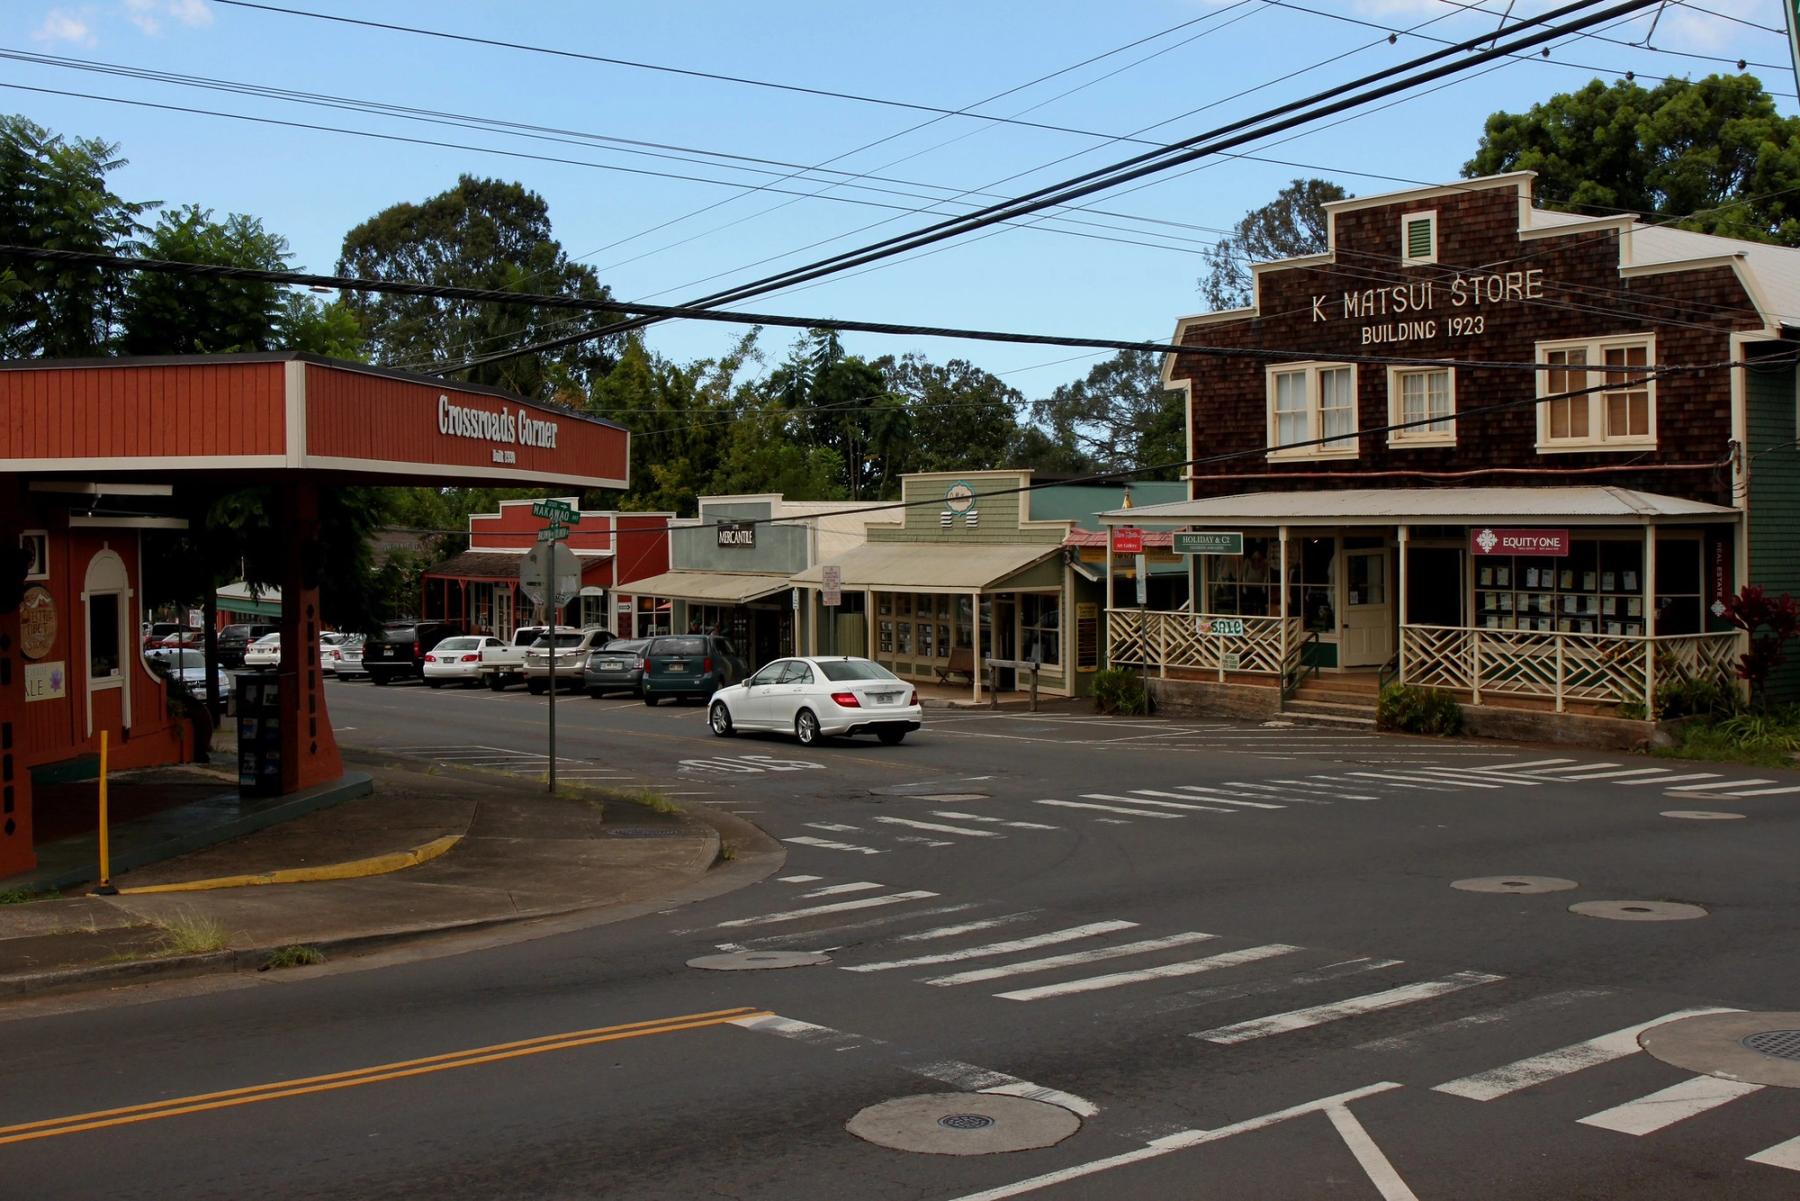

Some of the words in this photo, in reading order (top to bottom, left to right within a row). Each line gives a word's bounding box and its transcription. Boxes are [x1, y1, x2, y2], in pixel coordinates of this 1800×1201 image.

[1312, 294, 1327, 322] K
[1343, 281, 1433, 319] MATSUI
[1451, 268, 1544, 307] STORE
[1361, 320, 1436, 345] BUILDING
[1448, 315, 1484, 337] 1923
[438, 394, 515, 443] Crossroads
[518, 409, 558, 448] Corner
[533, 503, 570, 522] MAKAWAO
[718, 530, 753, 544] MERCANTILE
[1182, 535, 1214, 544] HOLIDAY
[1214, 535, 1221, 544] &
[1502, 537, 1539, 549] EQUITY
[1539, 537, 1561, 548] ONE
